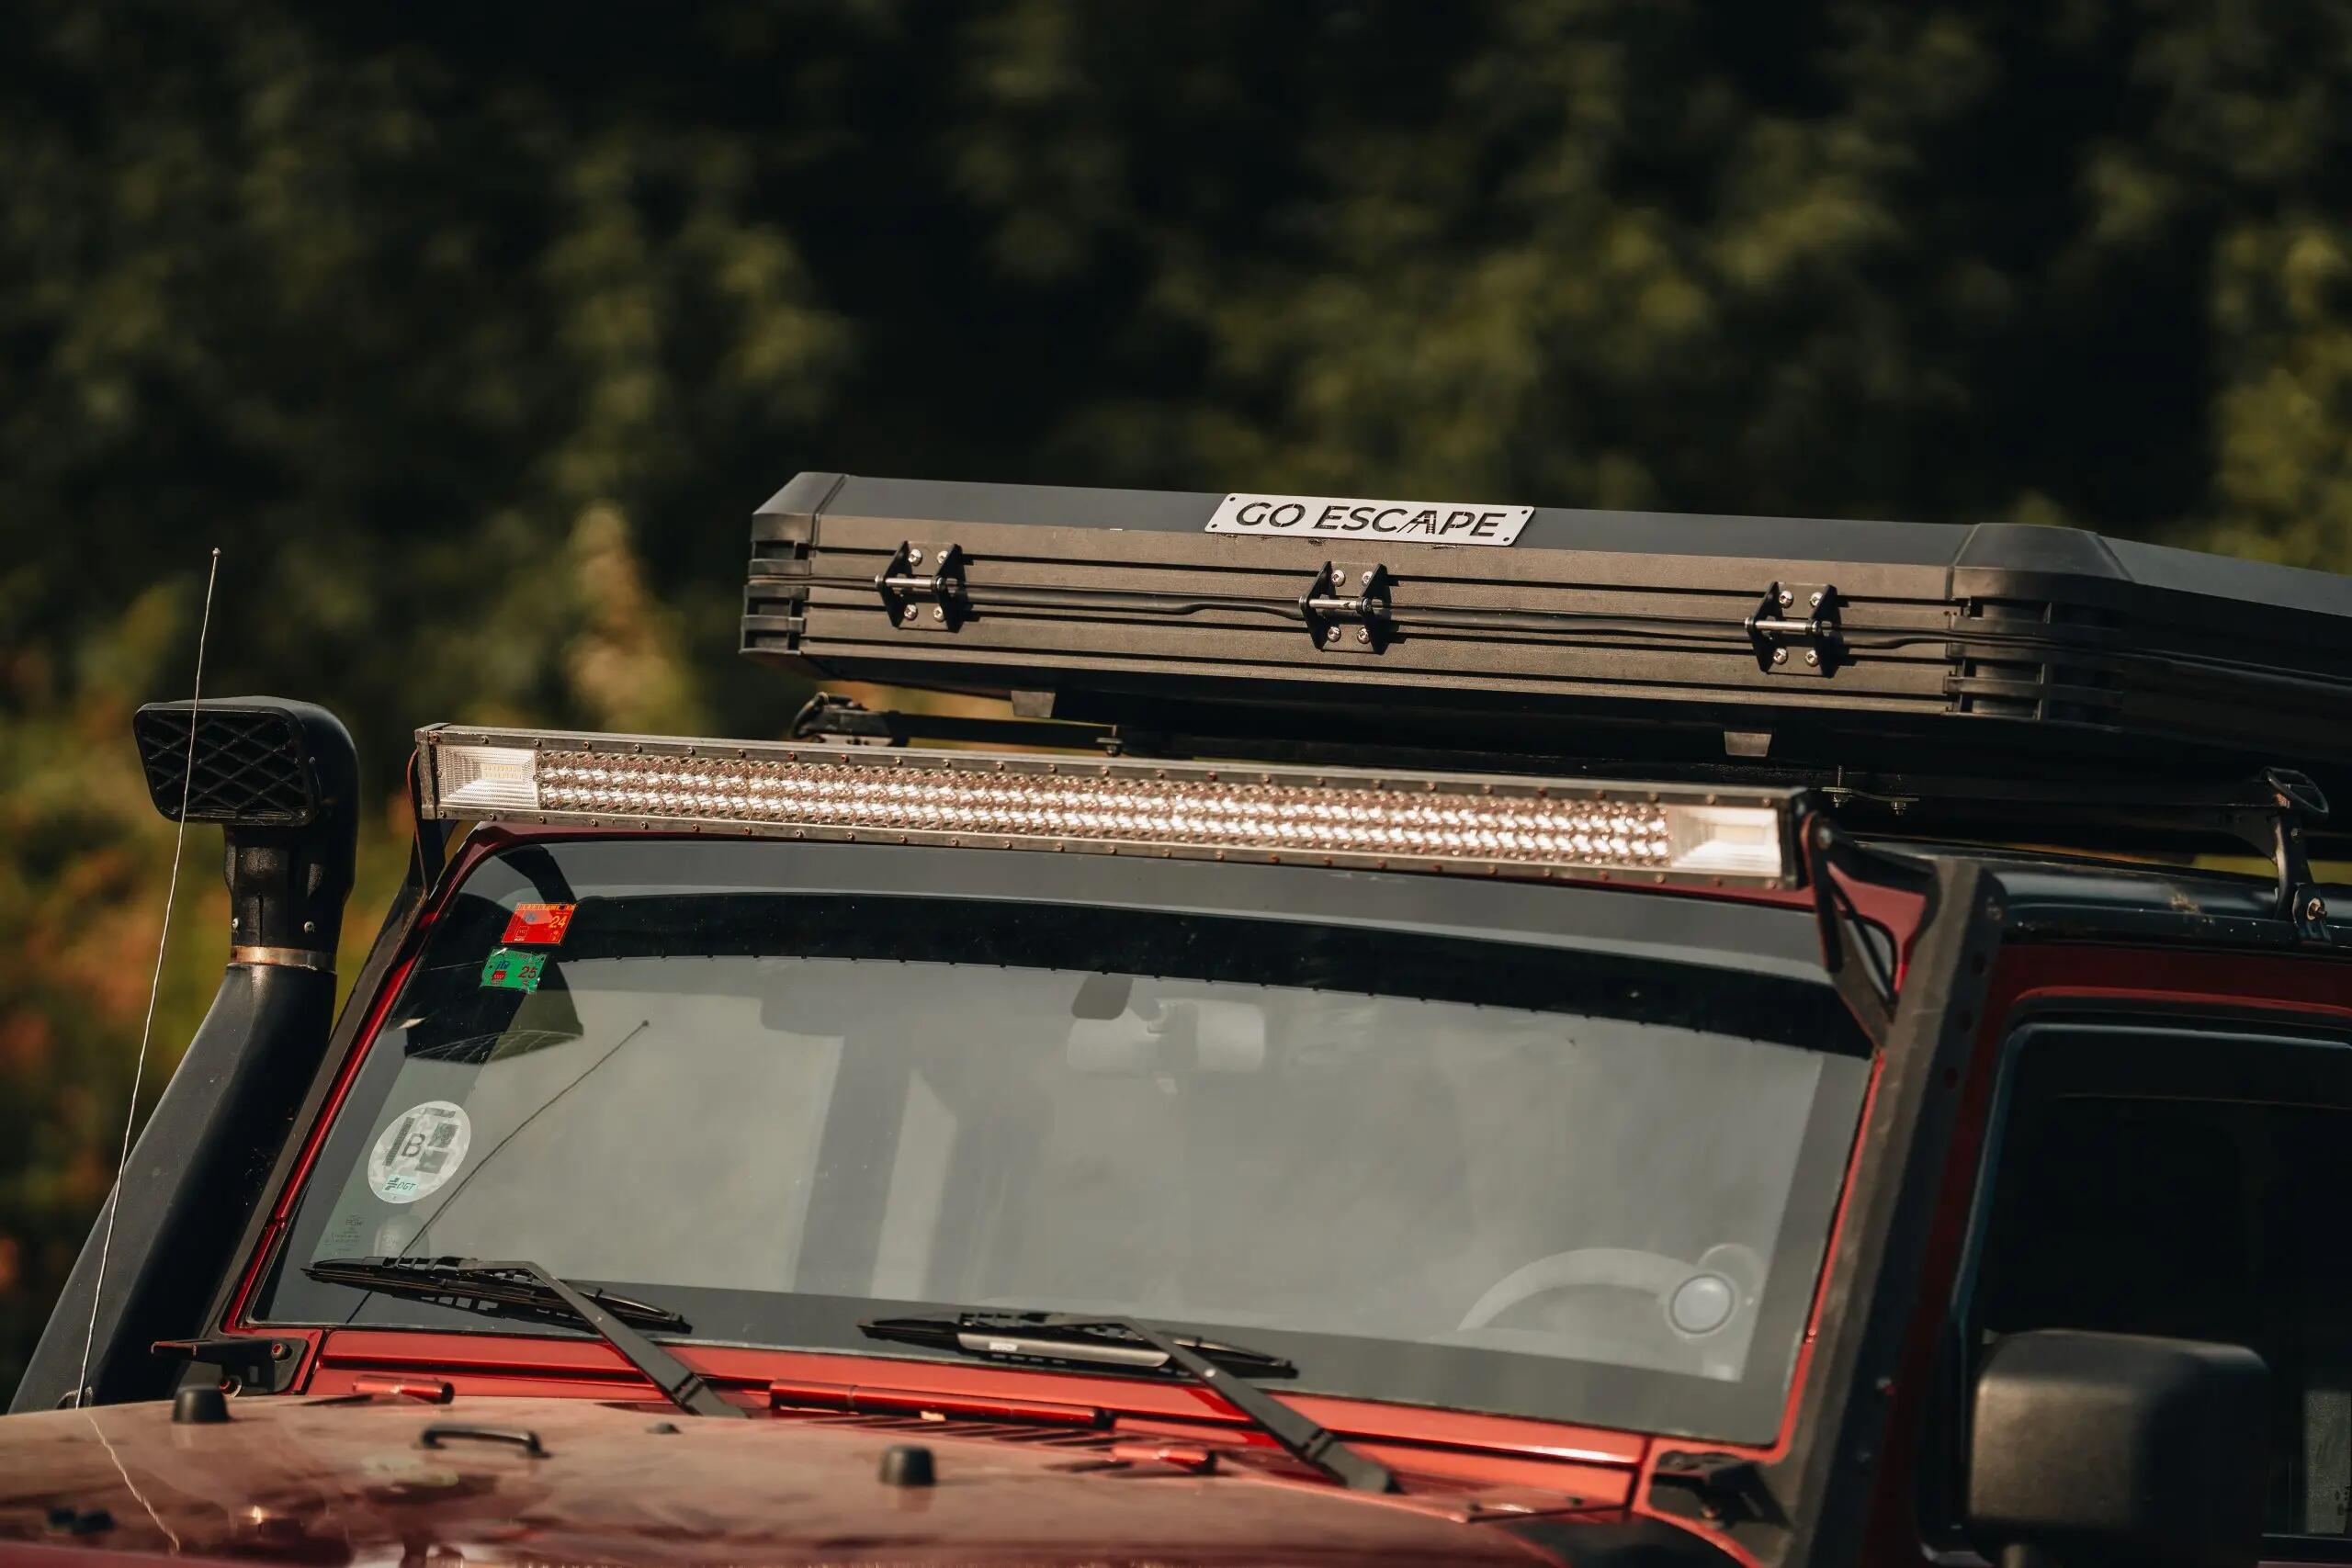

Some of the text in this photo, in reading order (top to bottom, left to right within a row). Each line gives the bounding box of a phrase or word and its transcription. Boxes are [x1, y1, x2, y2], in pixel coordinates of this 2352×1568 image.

[1236, 502, 1507, 536] GO ESCAPE
[548, 915, 568, 929] 24
[518, 965, 537, 978] 25
[401, 1133, 425, 1157] B
[397, 1182, 416, 1190] DGT
